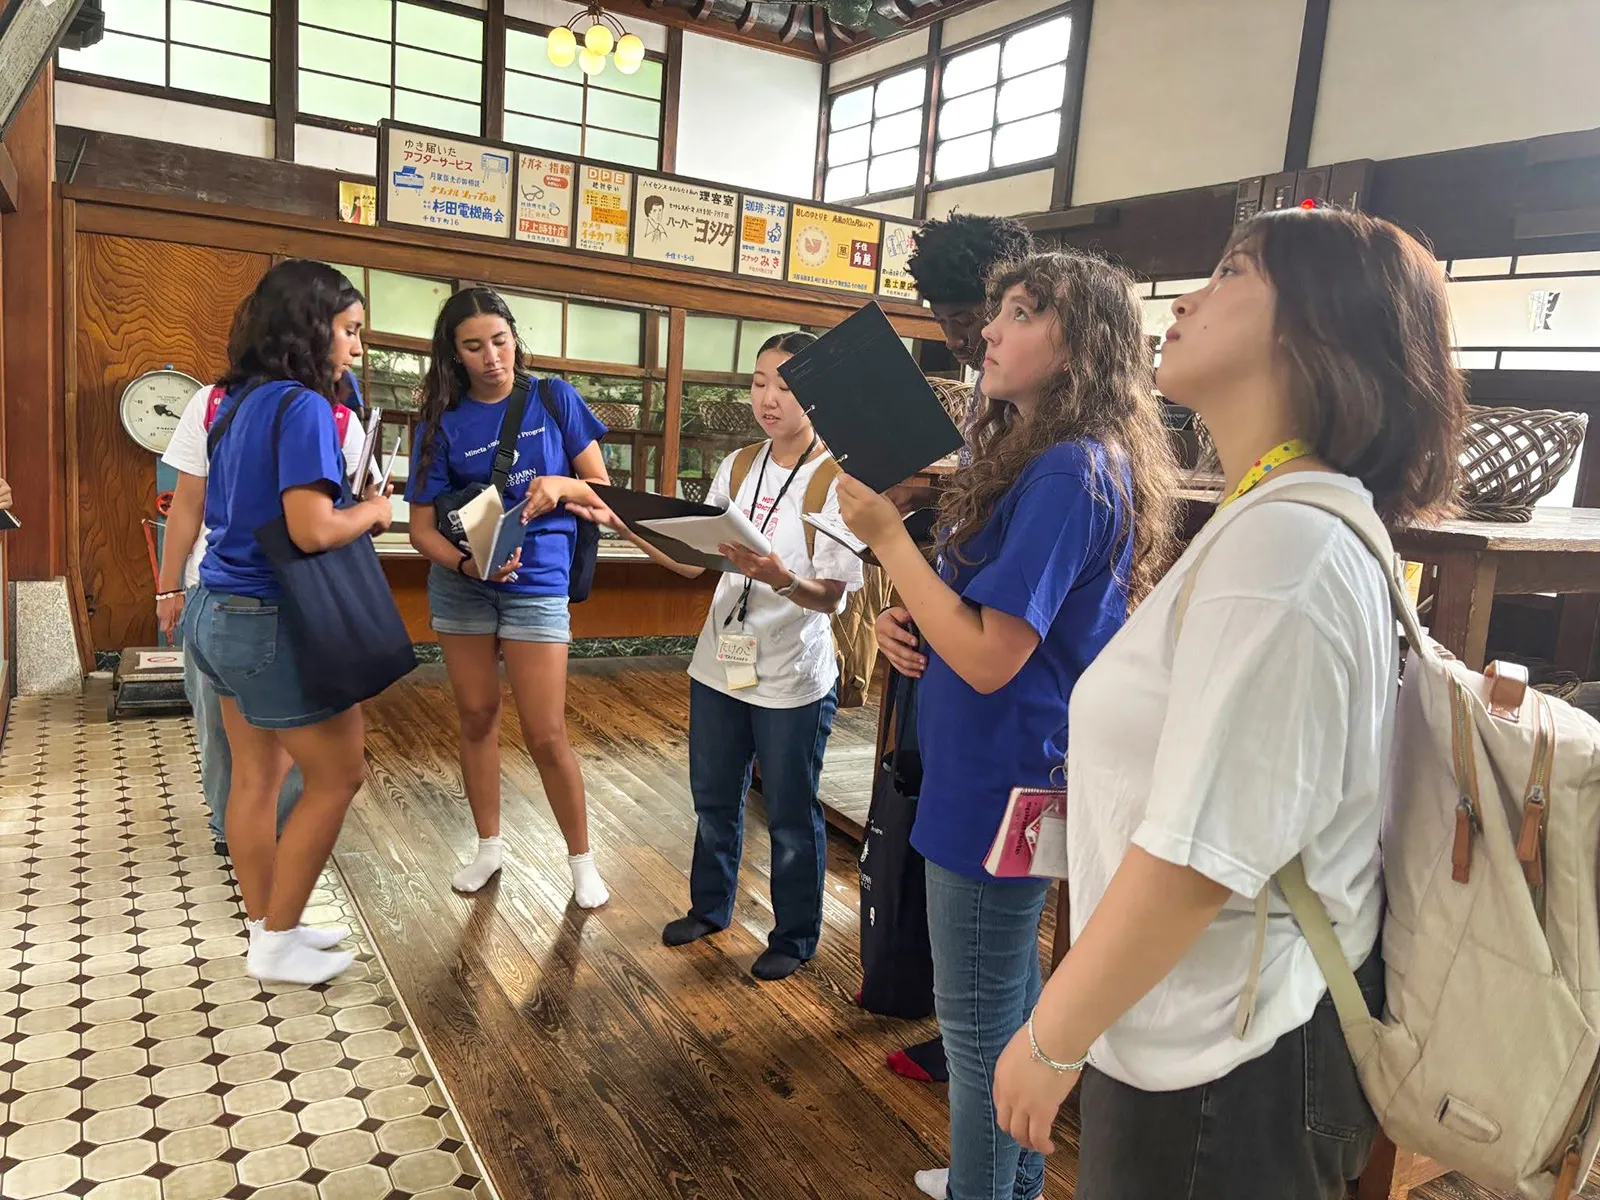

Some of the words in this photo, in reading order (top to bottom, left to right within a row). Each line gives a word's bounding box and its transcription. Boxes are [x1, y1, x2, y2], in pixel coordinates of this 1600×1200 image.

[404, 139, 457, 158] ゆき届いた
[404, 150, 473, 172] アフターサービス
[699, 190, 734, 207] 理客室
[433, 198, 505, 223] 杉田電機商会
[693, 217, 735, 247] ヨシダ
[741, 254, 759, 263] スナック
[760, 255, 780, 269] みき
[465, 447, 486, 458] Mineta
